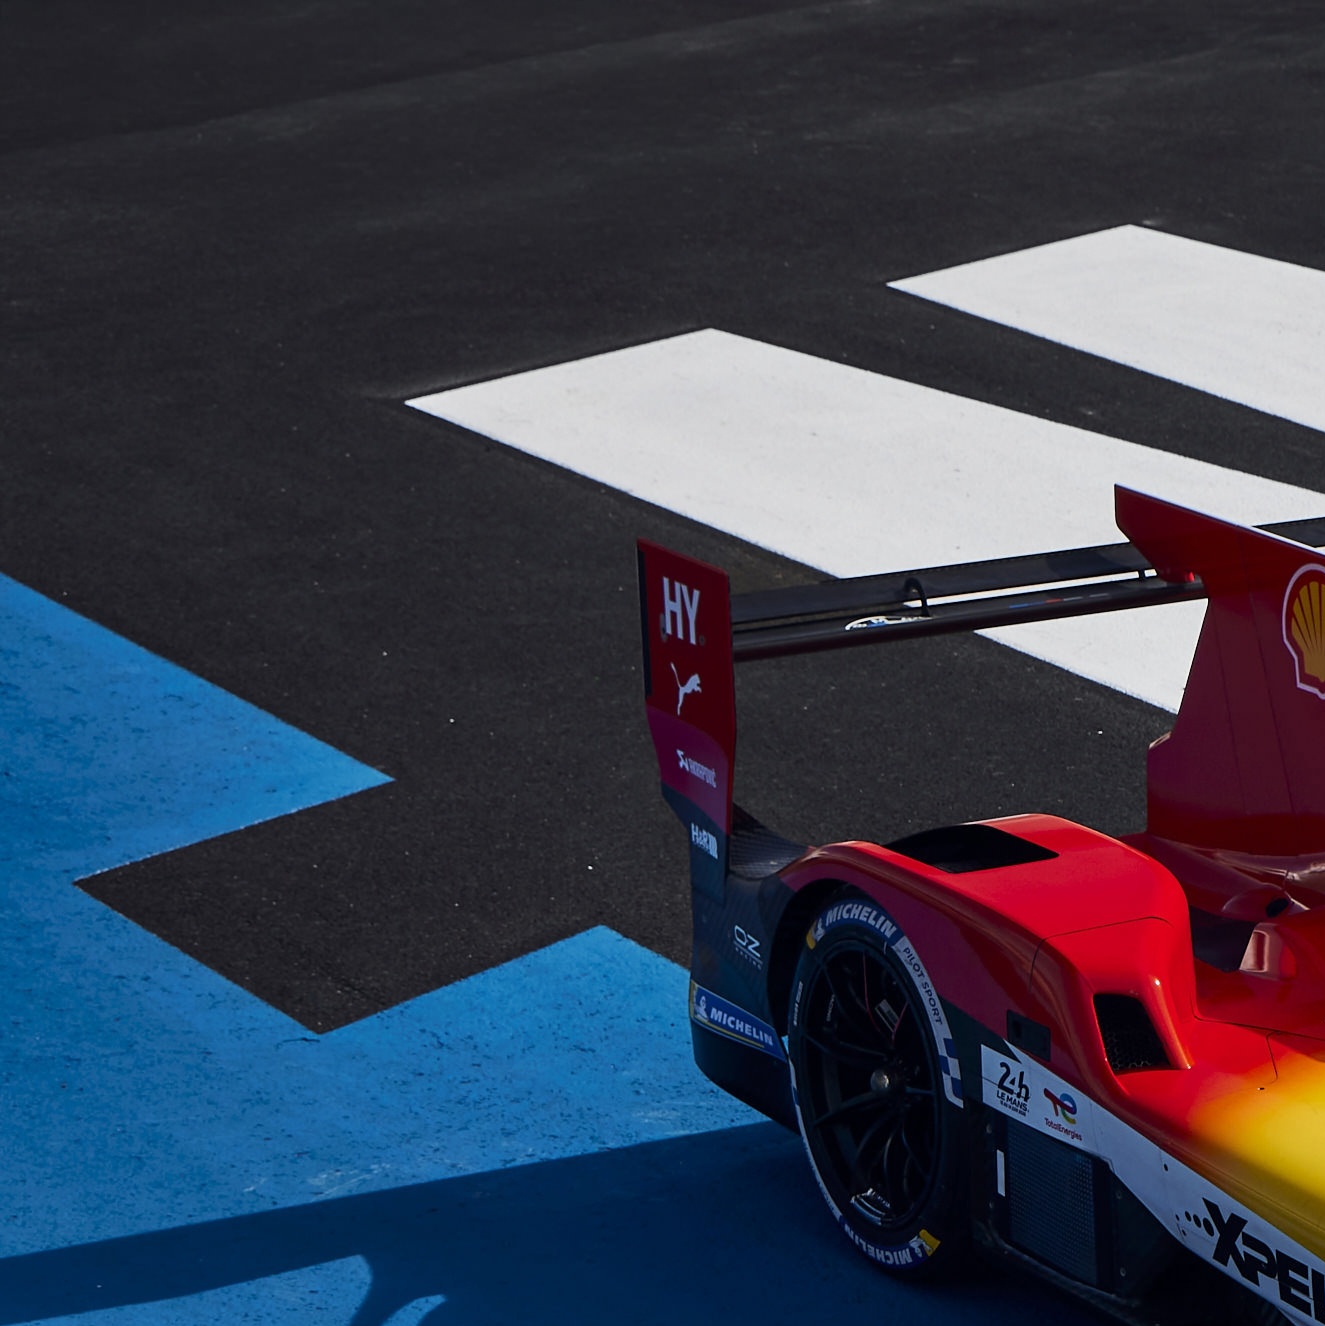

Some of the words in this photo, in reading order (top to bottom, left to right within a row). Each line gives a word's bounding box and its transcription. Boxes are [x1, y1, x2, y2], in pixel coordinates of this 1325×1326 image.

[662, 575, 701, 646] HY
[825, 903, 897, 939] MICHELIN
[734, 924, 762, 958] OZ
[903, 947, 925, 979] PILOT
[920, 982, 943, 1025] SPORT
[710, 1006, 774, 1046] MICHELIN
[996, 1089, 1006, 1101] LE
[1006, 1094, 1028, 1112] MANS
[1044, 1117, 1082, 1141] TotalEnergies
[844, 1223, 913, 1266] MICHELIN
